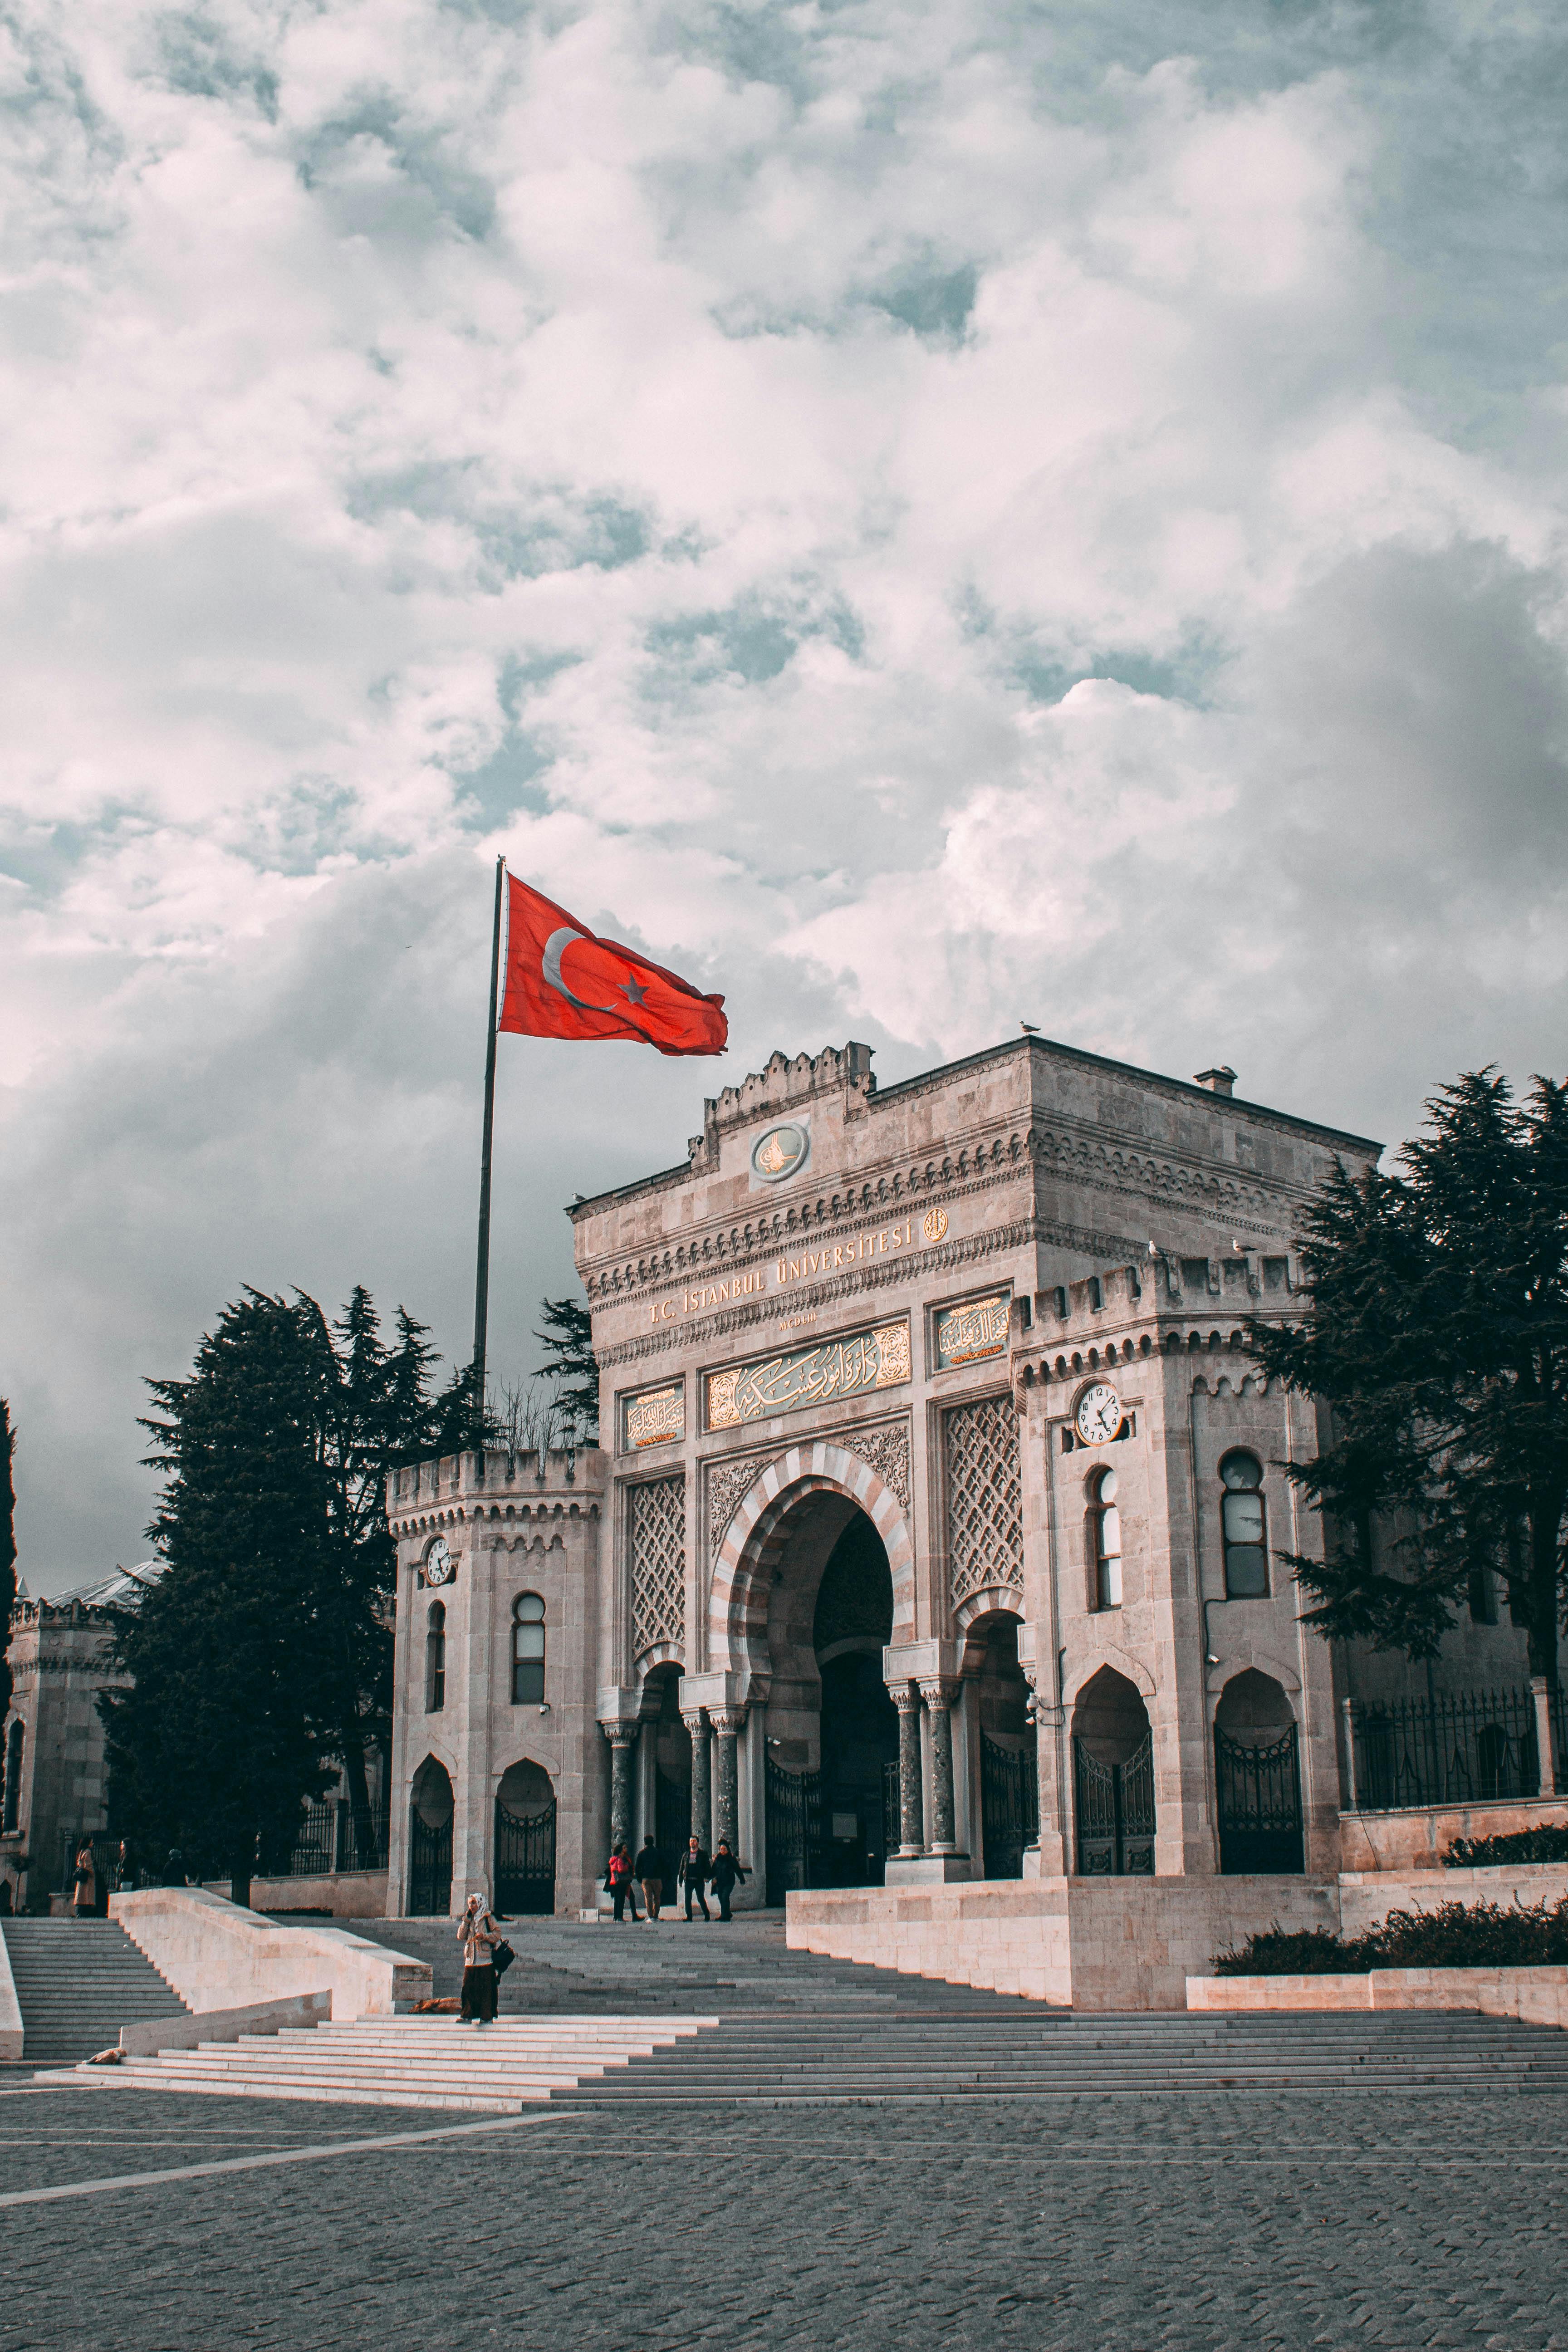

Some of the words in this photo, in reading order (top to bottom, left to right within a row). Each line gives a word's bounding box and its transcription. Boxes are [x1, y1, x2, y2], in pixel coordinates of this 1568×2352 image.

[684, 1272, 765, 1313] İSTANBUL
[776, 1218, 911, 1284] ÜNİVERSİTESİ
[779, 1312, 817, 1331] MCDLIII
[1096, 1388, 1102, 1396] 12
[1088, 1393, 1093, 1401] 11
[1083, 1402, 1088, 1411] 10
[1114, 1406, 1119, 1415] 3
[1081, 1414, 1086, 1422] 9
[1084, 1425, 1089, 1433] 8
[1106, 1427, 1112, 1436] 5
[1098, 1432, 1103, 1441] 6
